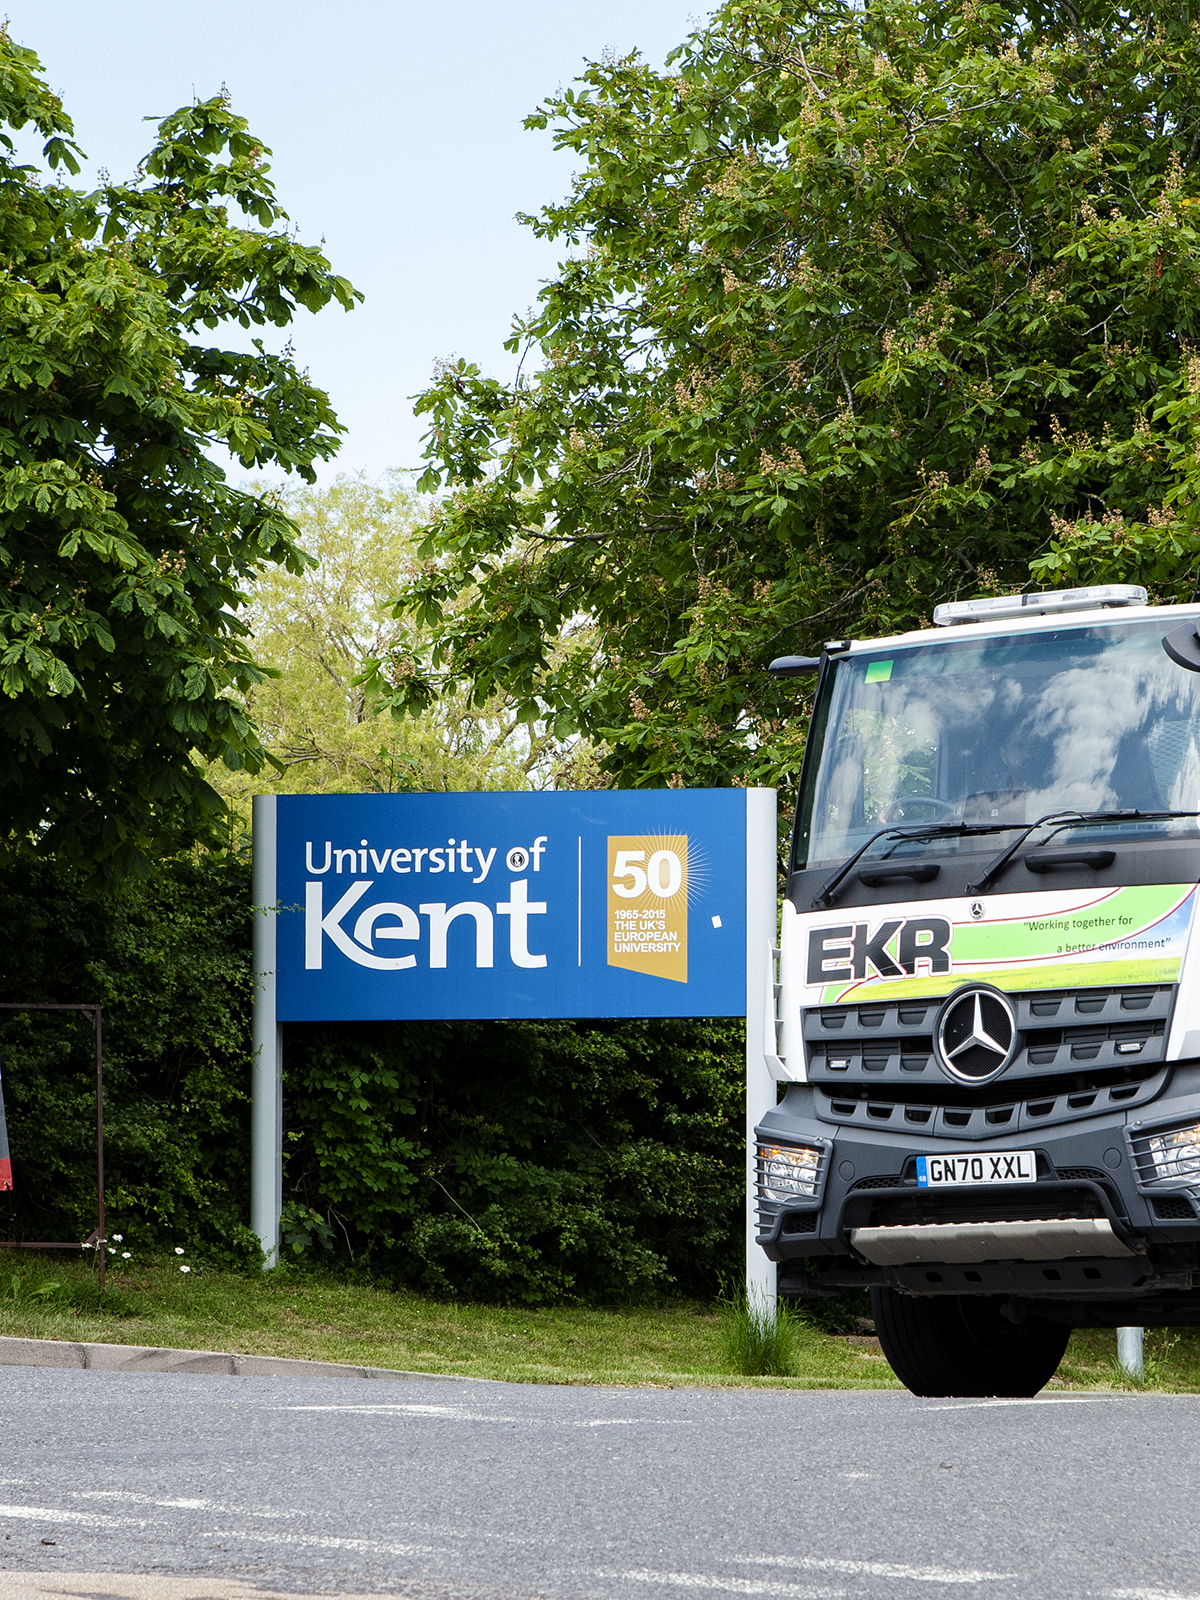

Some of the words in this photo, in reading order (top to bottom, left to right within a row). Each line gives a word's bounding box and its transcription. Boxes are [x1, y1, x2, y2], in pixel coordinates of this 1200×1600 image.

[305, 837, 498, 884] University
[506, 835, 548, 873] of
[611, 849, 682, 899] 50
[614, 909, 666, 920] 1965-2015
[1072, 916, 1116, 930] together
[1118, 914, 1134, 926] for
[304, 878, 548, 971] Kent
[614, 920, 637, 931] THE
[639, 920, 666, 931] UK'S
[614, 931, 678, 942] EUROPEAN
[614, 942, 682, 953] UNIVERSITY
[804, 914, 954, 987] EKR
[1056, 945, 1063, 953] a
[1065, 943, 1097, 953] better
[930, 1157, 983, 1182] GN70
[989, 1155, 1030, 1179] XXL
